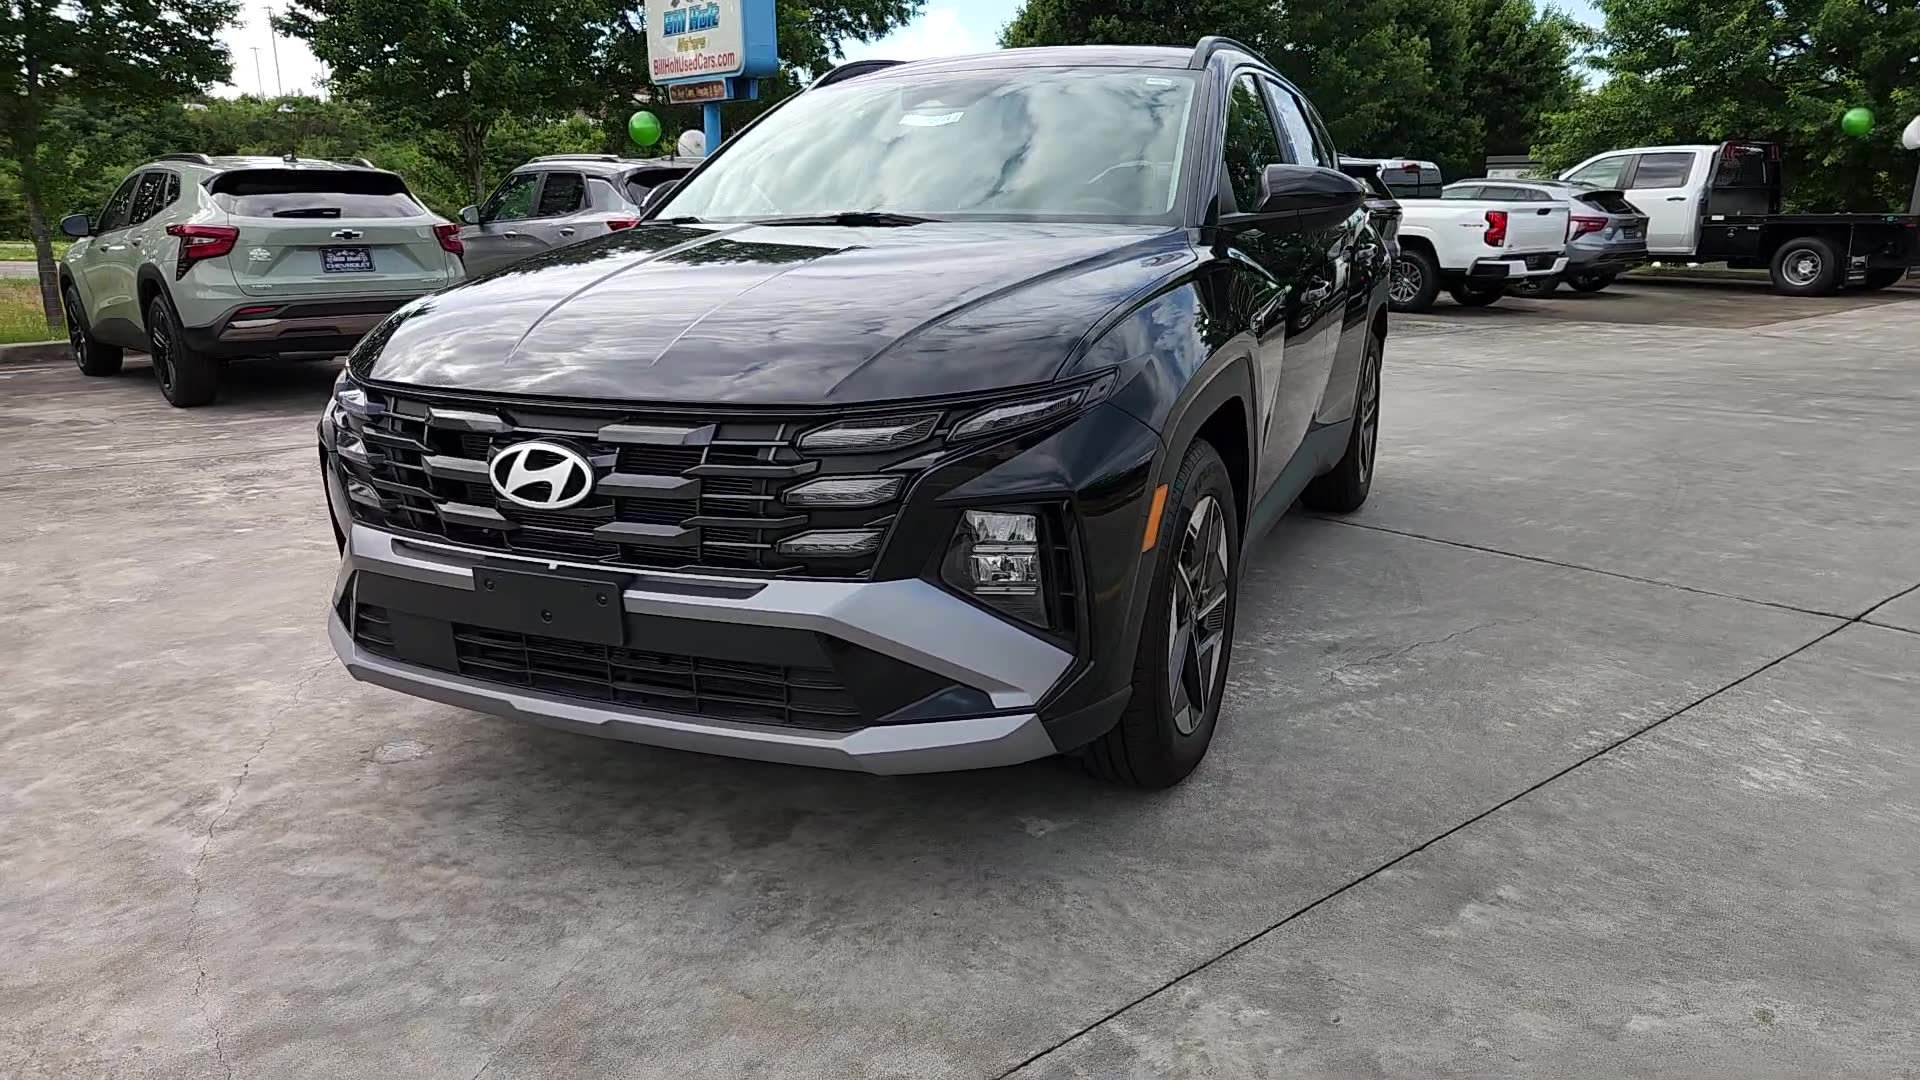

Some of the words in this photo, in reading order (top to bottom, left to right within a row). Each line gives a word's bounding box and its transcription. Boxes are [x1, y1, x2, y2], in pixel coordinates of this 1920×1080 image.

[663, 9, 686, 36] Bill
[688, 3, 719, 32] Holt
[653, 52, 735, 75] BillHoltUsedCars.com
